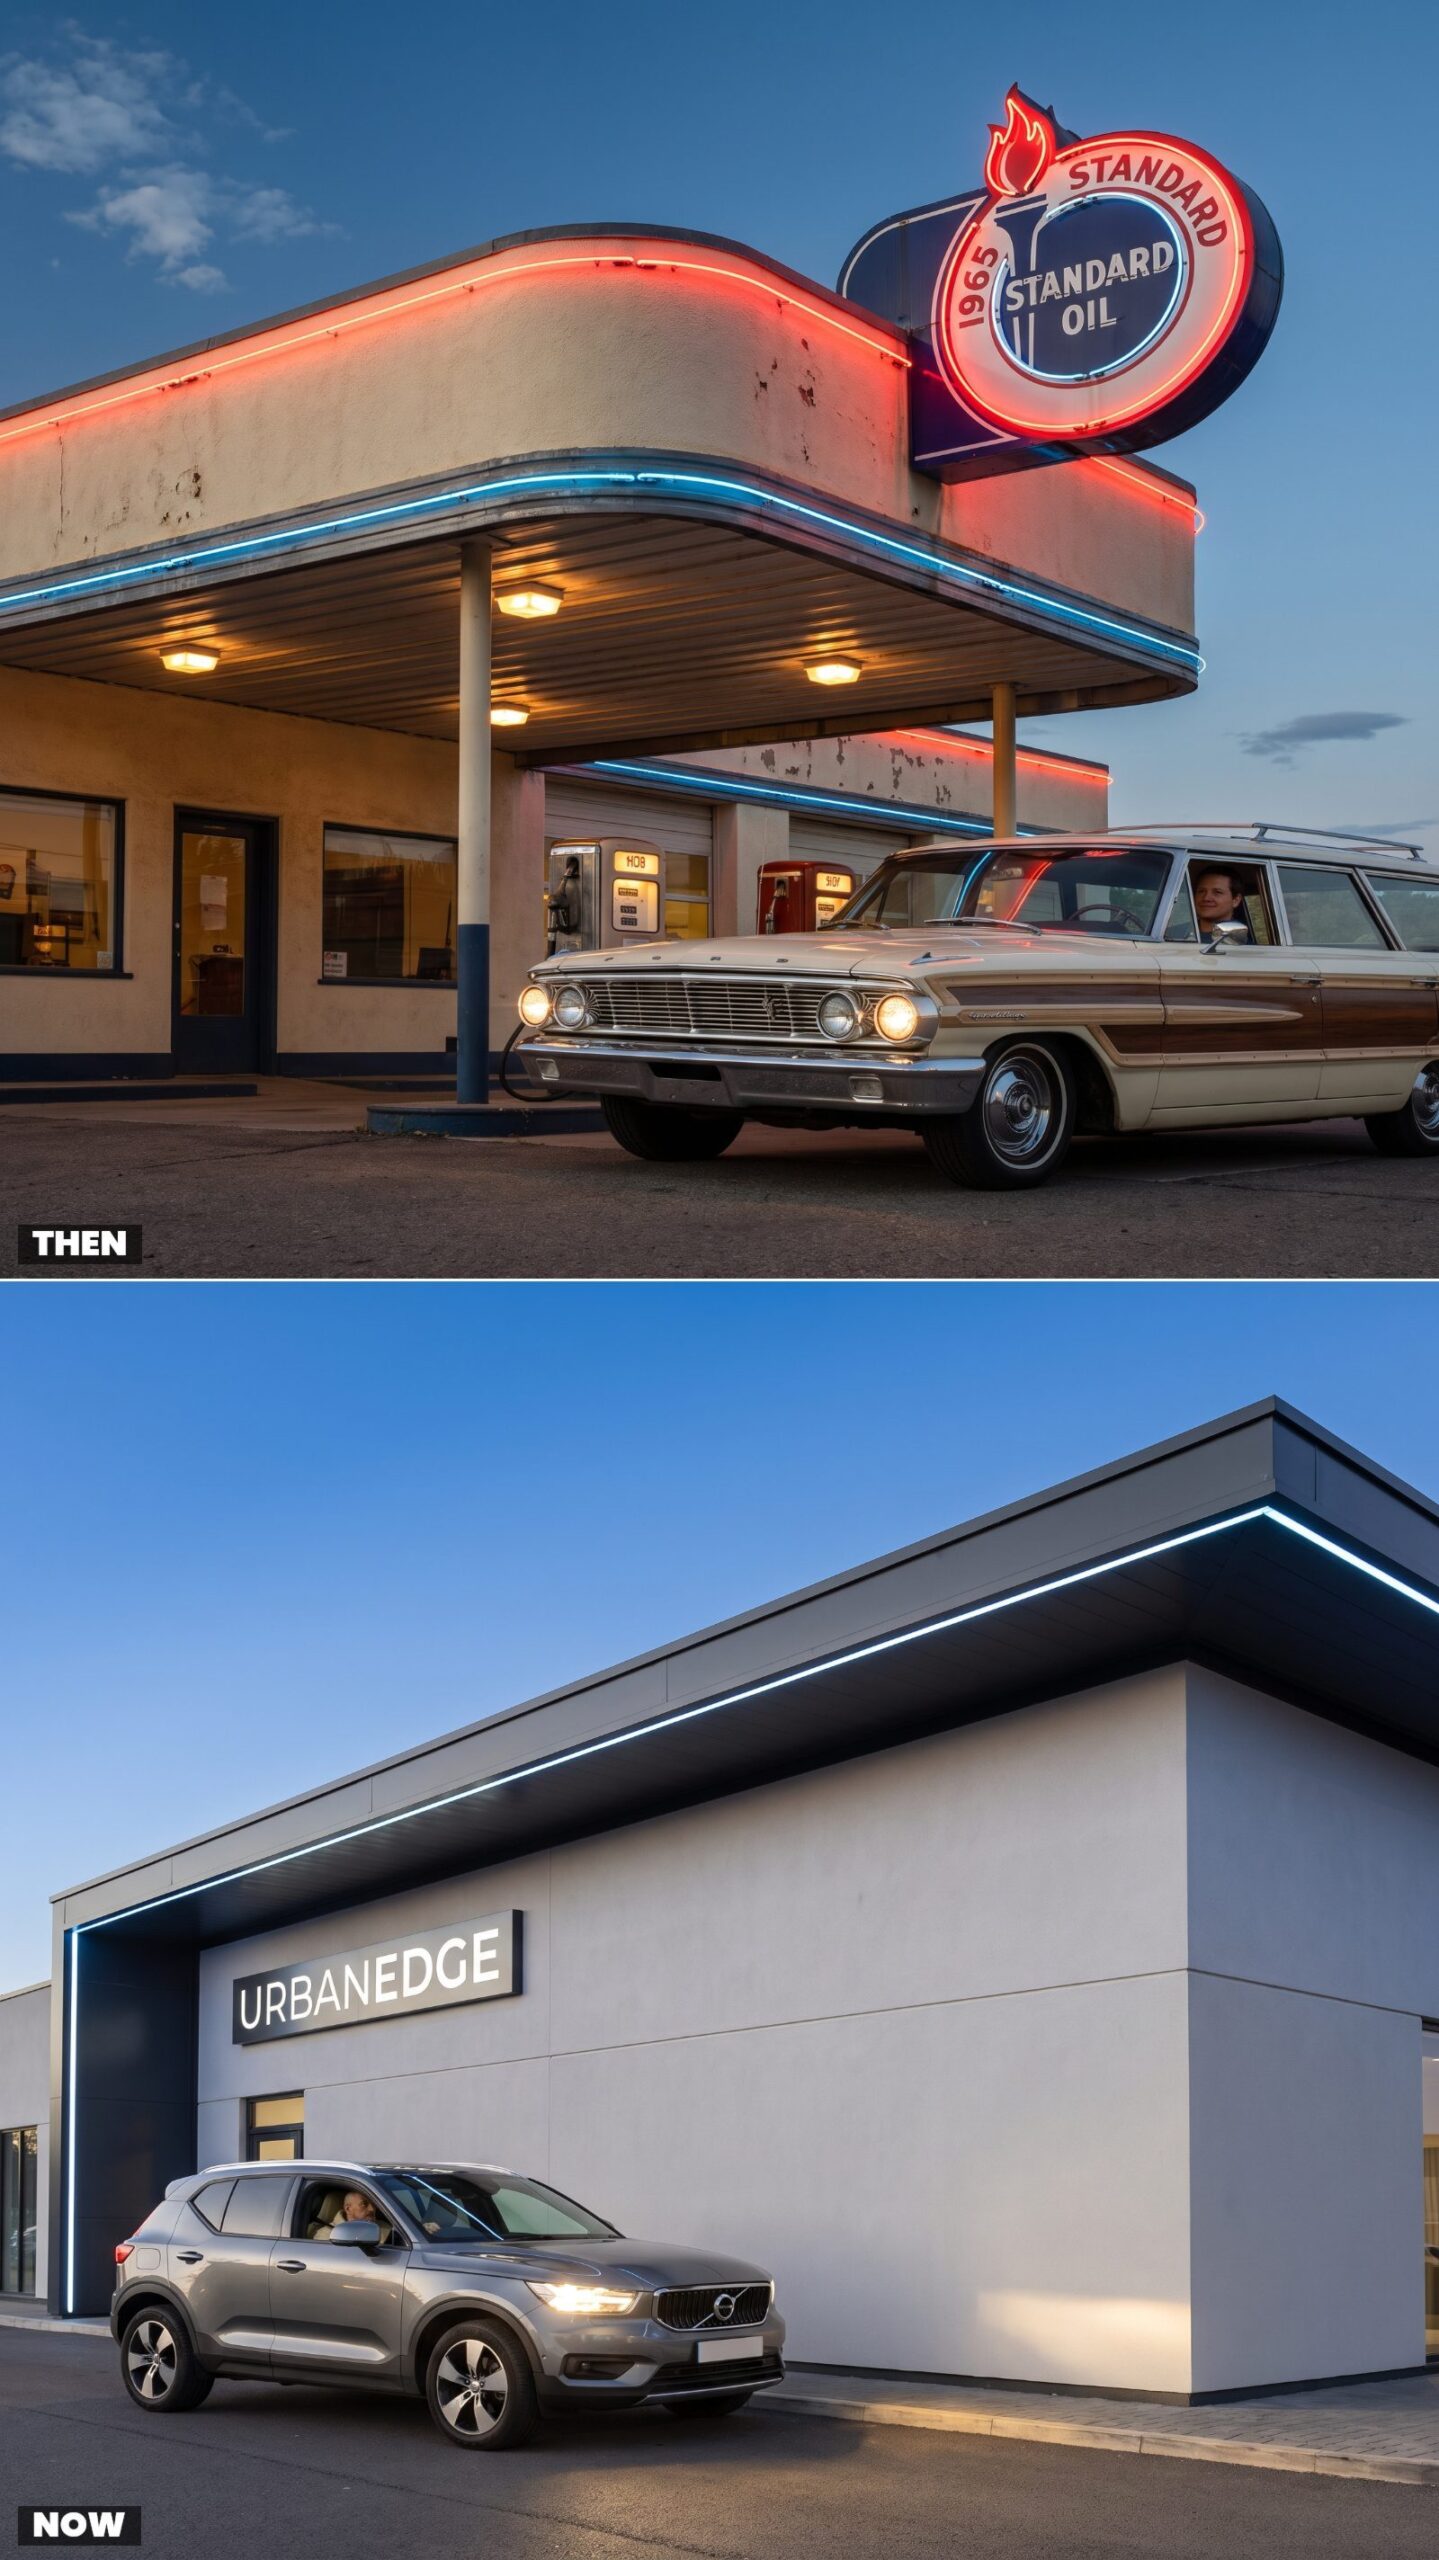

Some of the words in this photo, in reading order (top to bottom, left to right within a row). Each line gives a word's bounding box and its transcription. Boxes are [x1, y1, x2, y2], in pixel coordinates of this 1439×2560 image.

[1069, 154, 1228, 248] STANDARD
[958, 245, 999, 330] 1965
[1005, 240, 1175, 312] STANDARD
[1061, 297, 1117, 336] OIL
[240, 1927, 500, 2030] URBANEDGE
